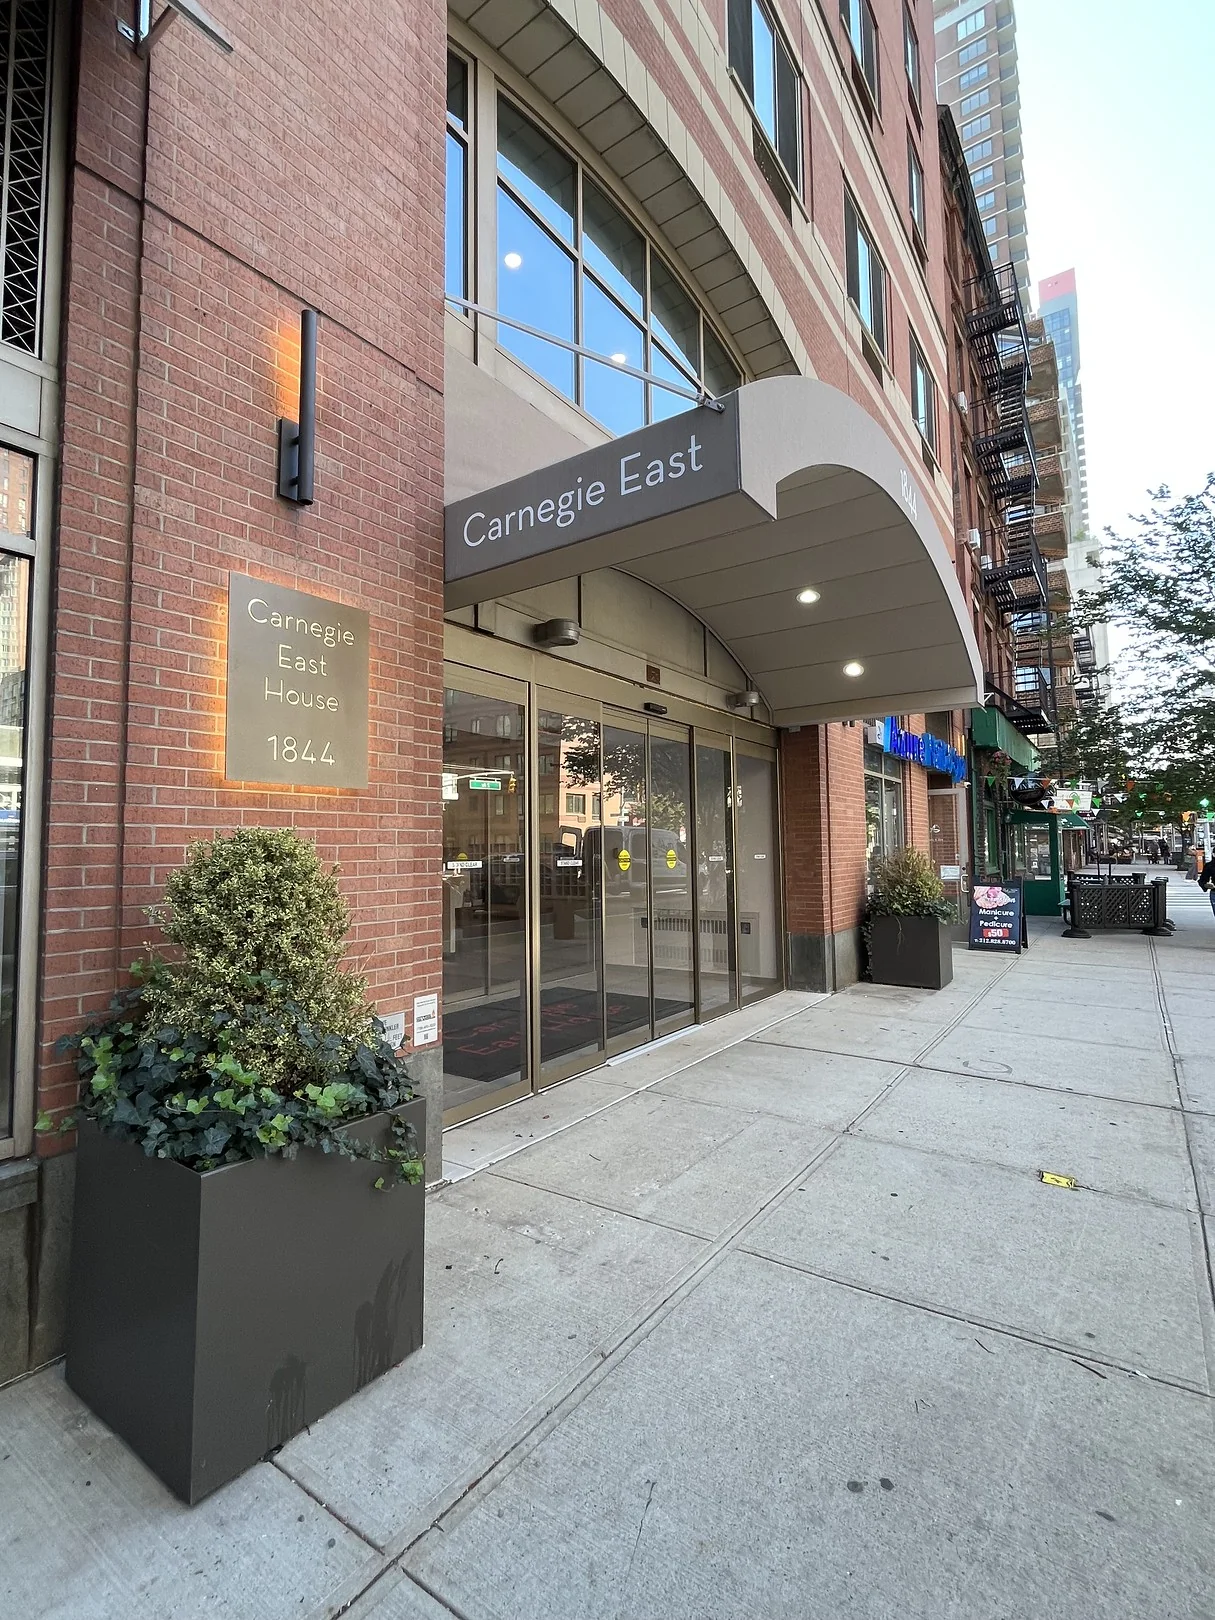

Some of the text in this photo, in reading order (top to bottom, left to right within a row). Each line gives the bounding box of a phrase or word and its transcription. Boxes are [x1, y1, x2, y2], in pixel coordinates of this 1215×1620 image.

[462, 434, 704, 547] Carnegie East
[900, 468, 918, 521] 1844
[247, 598, 355, 648] Carnegie
[277, 643, 328, 677] East
[263, 676, 340, 712] House
[267, 734, 336, 766] 1844
[979, 920, 1013, 928] Pedicure
[988, 929, 1004, 938] $50
